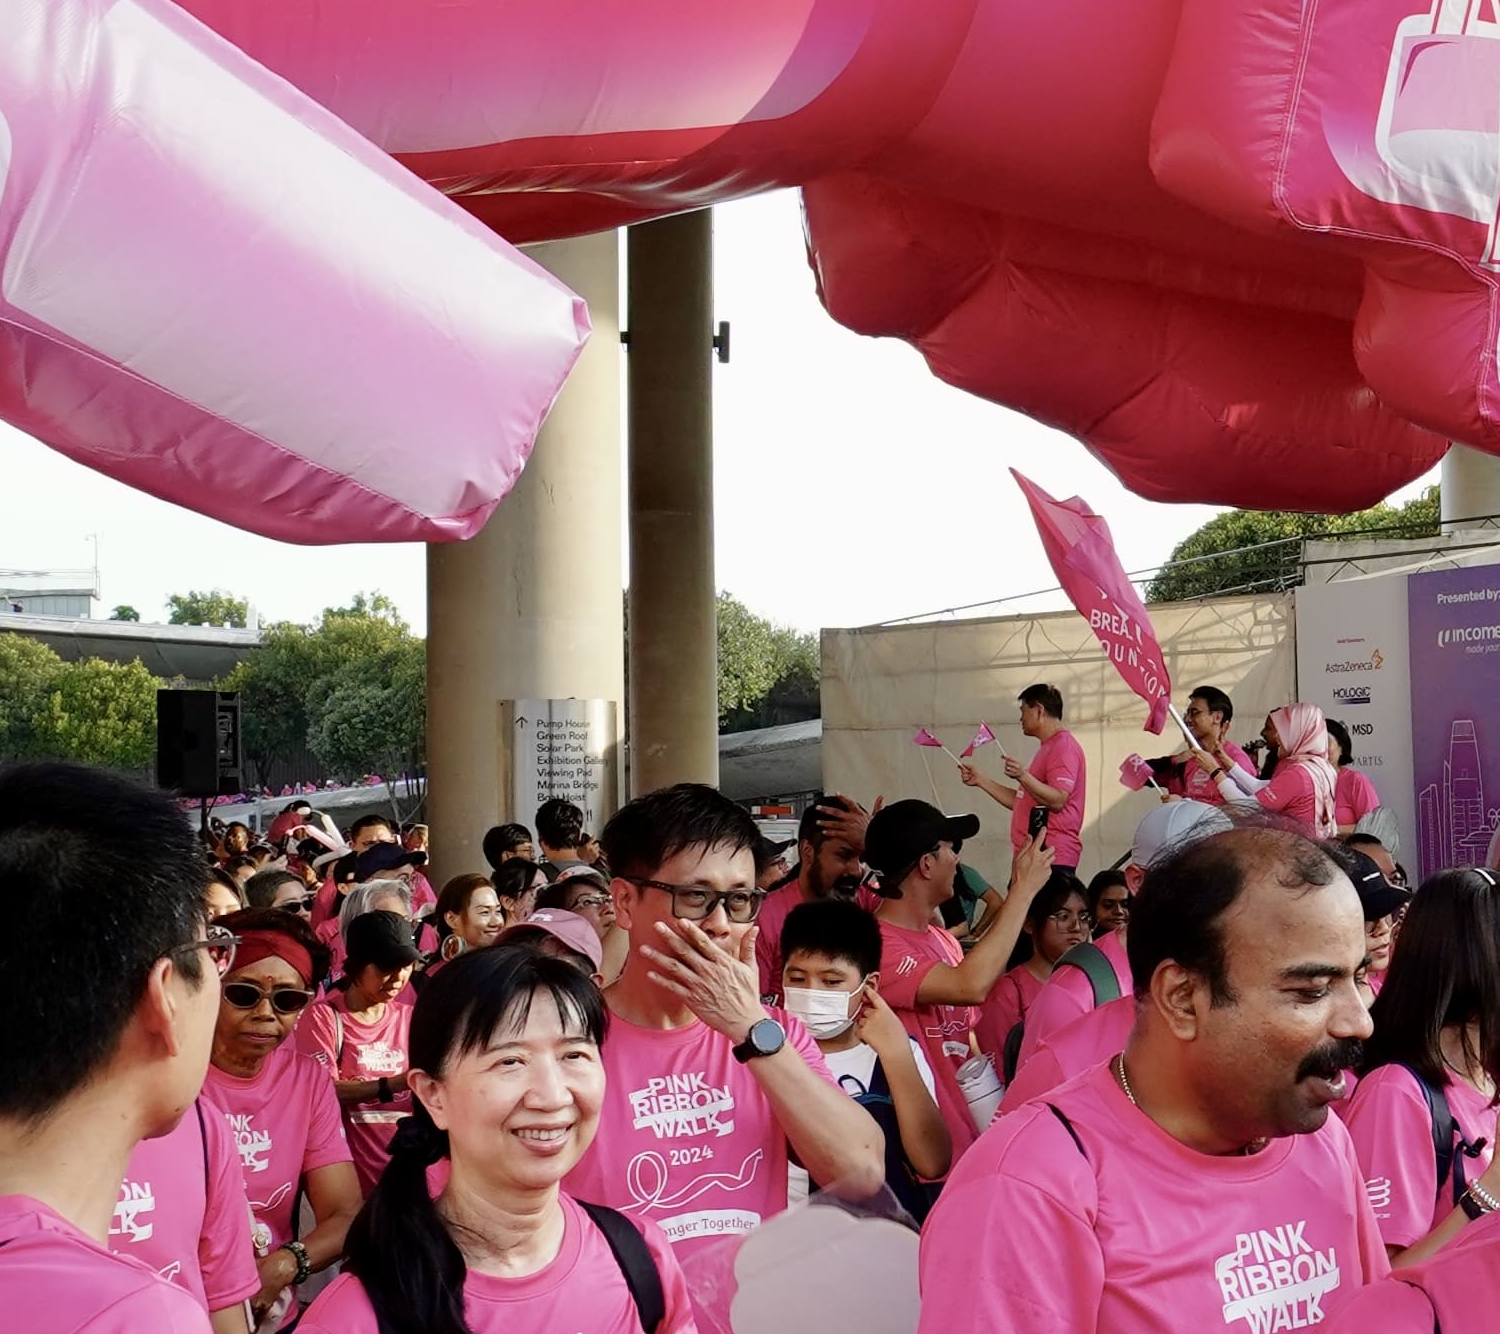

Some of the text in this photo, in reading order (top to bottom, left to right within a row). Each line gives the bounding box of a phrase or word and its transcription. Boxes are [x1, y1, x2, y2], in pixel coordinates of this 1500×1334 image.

[1437, 589, 1485, 604] Presented
[1090, 608, 1135, 641] BREA
[1325, 661, 1373, 673] AstraZeneca
[1333, 687, 1371, 698] HOLOGIC
[536, 731, 566, 740] Green
[1352, 724, 1373, 735] MSD
[564, 744, 584, 752] Park
[537, 756, 581, 765] Exhibition
[537, 768, 592, 779] Viewing Pad
[537, 781, 599, 791] Marina Bridge
[648, 1072, 710, 1096] PINK
[634, 1085, 732, 1117] RIBBON
[651, 1112, 723, 1138] WALK
[669, 1145, 714, 1166] 2024
[702, 1215, 755, 1231] Together
[1235, 1220, 1313, 1267] PINK
[1218, 1248, 1337, 1303] RIBBON
